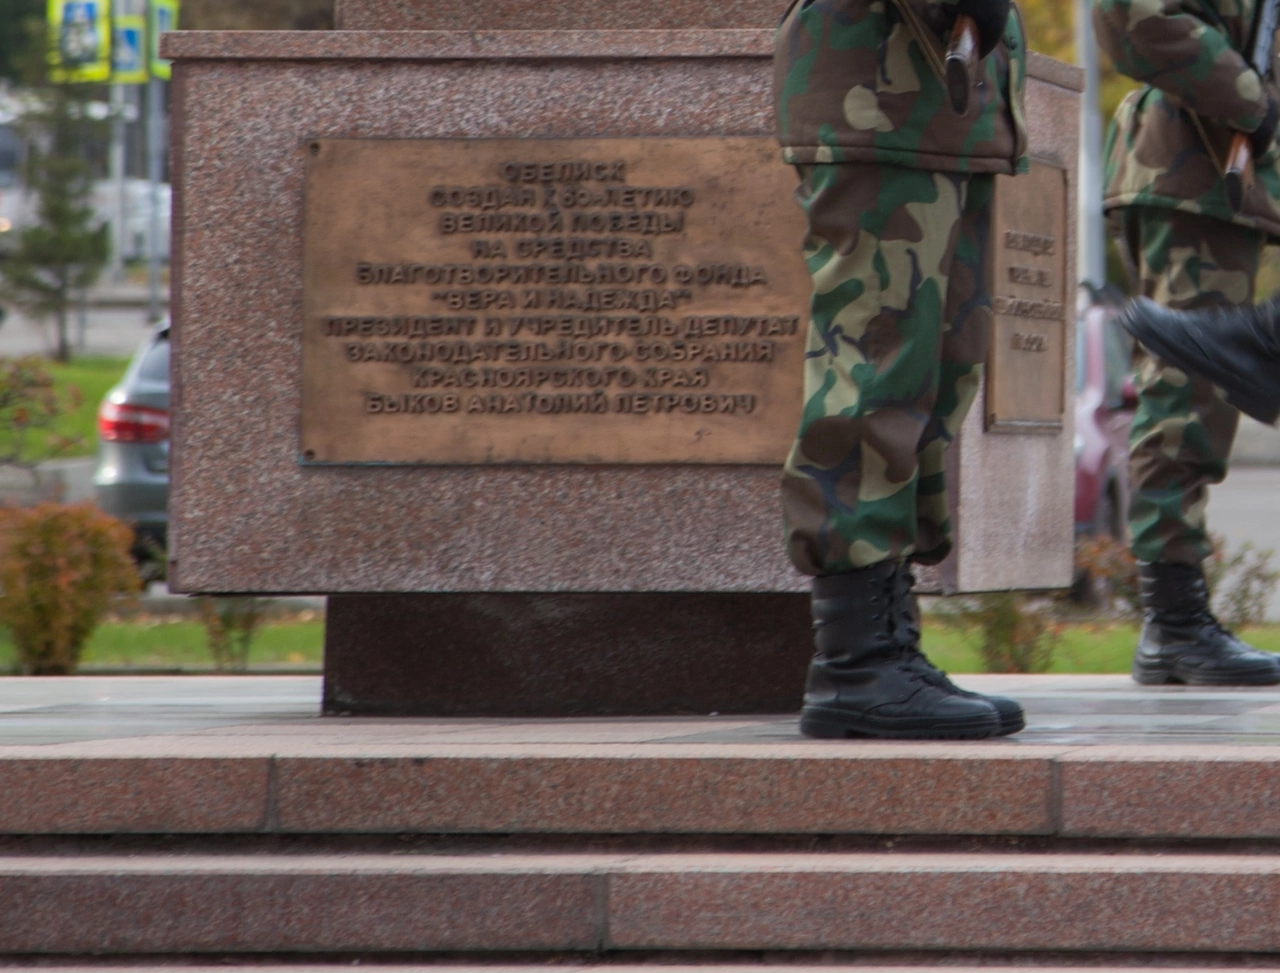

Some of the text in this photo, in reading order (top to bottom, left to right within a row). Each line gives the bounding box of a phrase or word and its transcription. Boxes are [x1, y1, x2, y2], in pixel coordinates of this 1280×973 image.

[503, 160, 627, 182] ОБЕЛИСК
[430, 186, 695, 210] СОЗДАН К 60-ЛЕТИЮ
[439, 206, 685, 235] ВЕЛИКОЙ ПОБЕДЫ
[470, 239, 652, 261] НА СРЕДСТВА
[356, 263, 768, 287] БЛАГОТВОРИТЕЛЬНОГО ФОНДА
[521, 290, 541, 309] И
[323, 316, 798, 339] ПРЕЗИДЕНТ И УЧРЕДИТЕЛЬ ДЕПУТАТ
[346, 341, 775, 364] ЗАКОНОДАТЕЛЬНОГО СОБРАНИЯ
[411, 367, 708, 388] КРАСНОЯРСКОГО КРАЯ
[364, 389, 756, 414] БЫКОВ АНАТОЛИЙ ПЕТРОВИЧ
